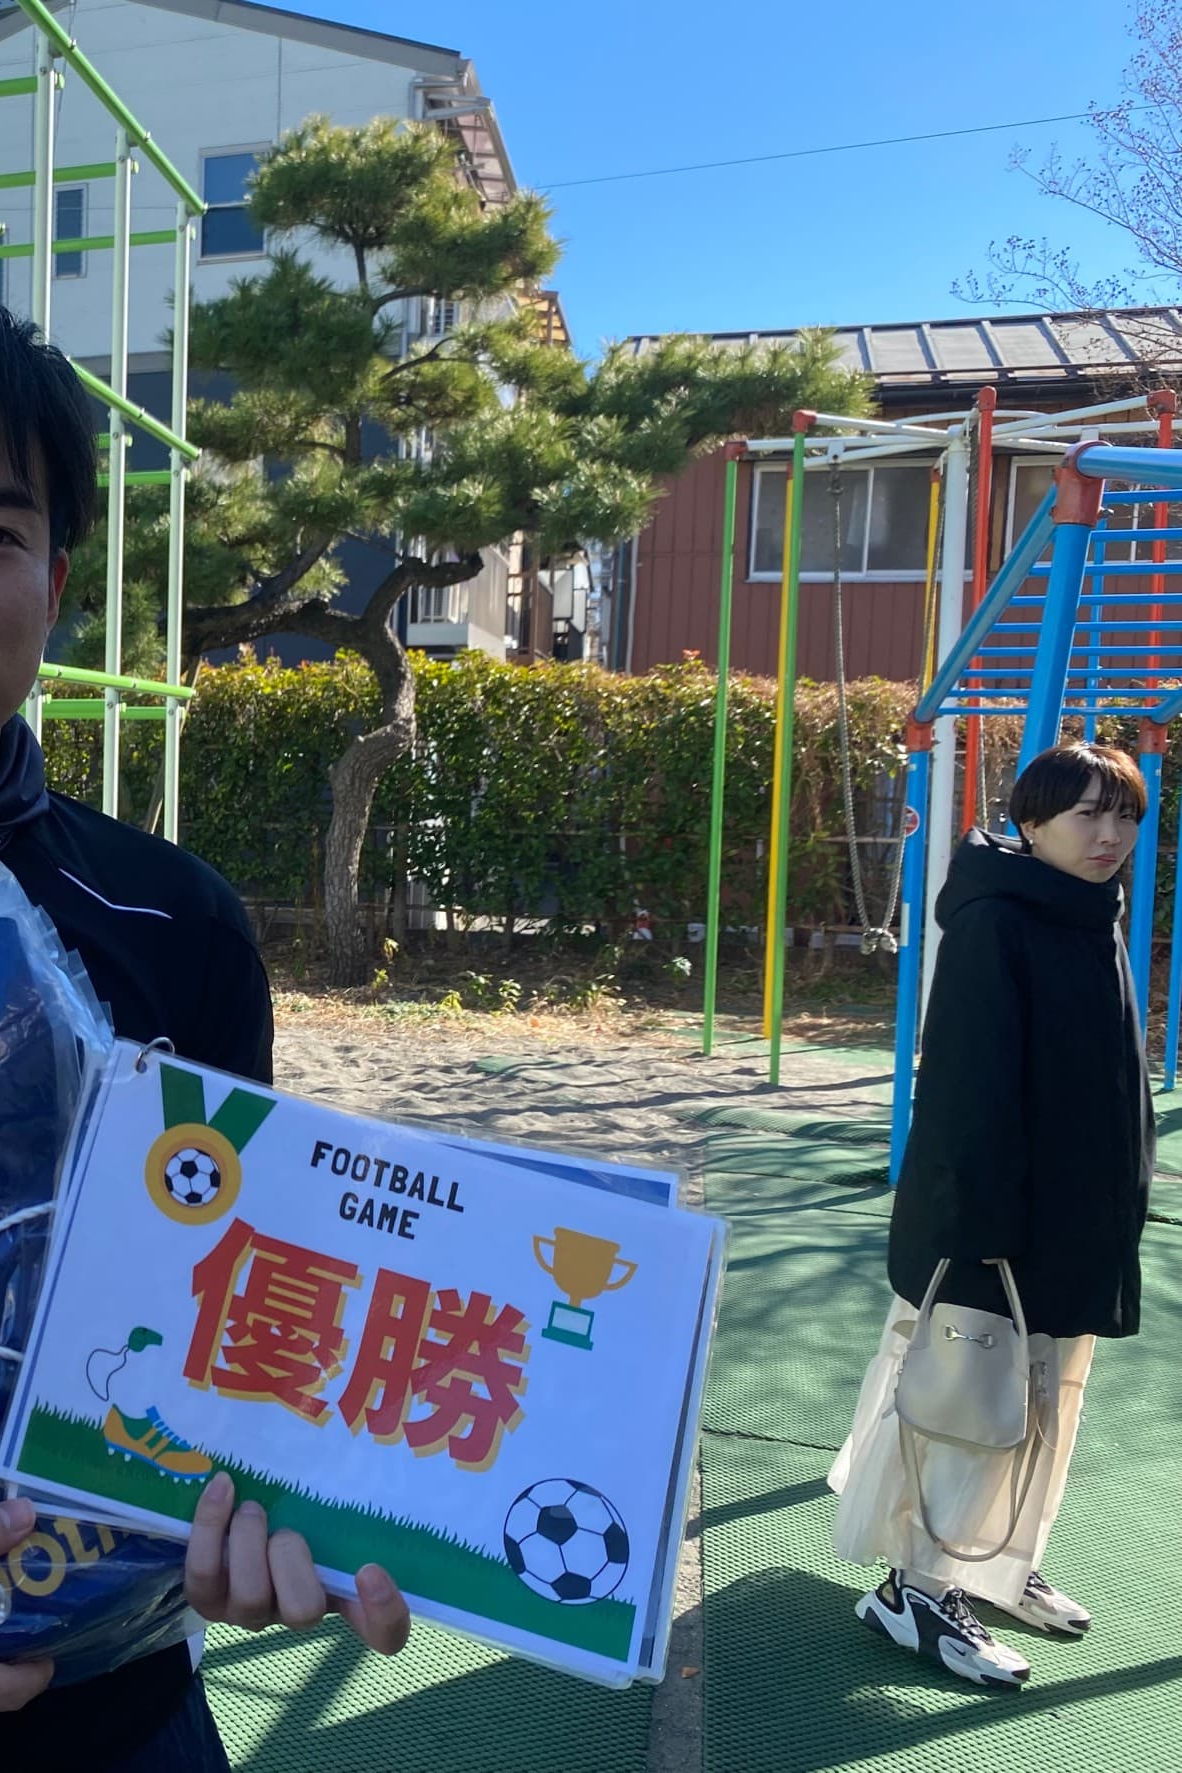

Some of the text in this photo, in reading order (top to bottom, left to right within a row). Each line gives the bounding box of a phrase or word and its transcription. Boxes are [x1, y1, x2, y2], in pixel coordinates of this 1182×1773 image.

[311, 1141, 464, 1212] FOOTBALL
[339, 1192, 420, 1239] GAME
[183, 1217, 531, 1472] 優勝
